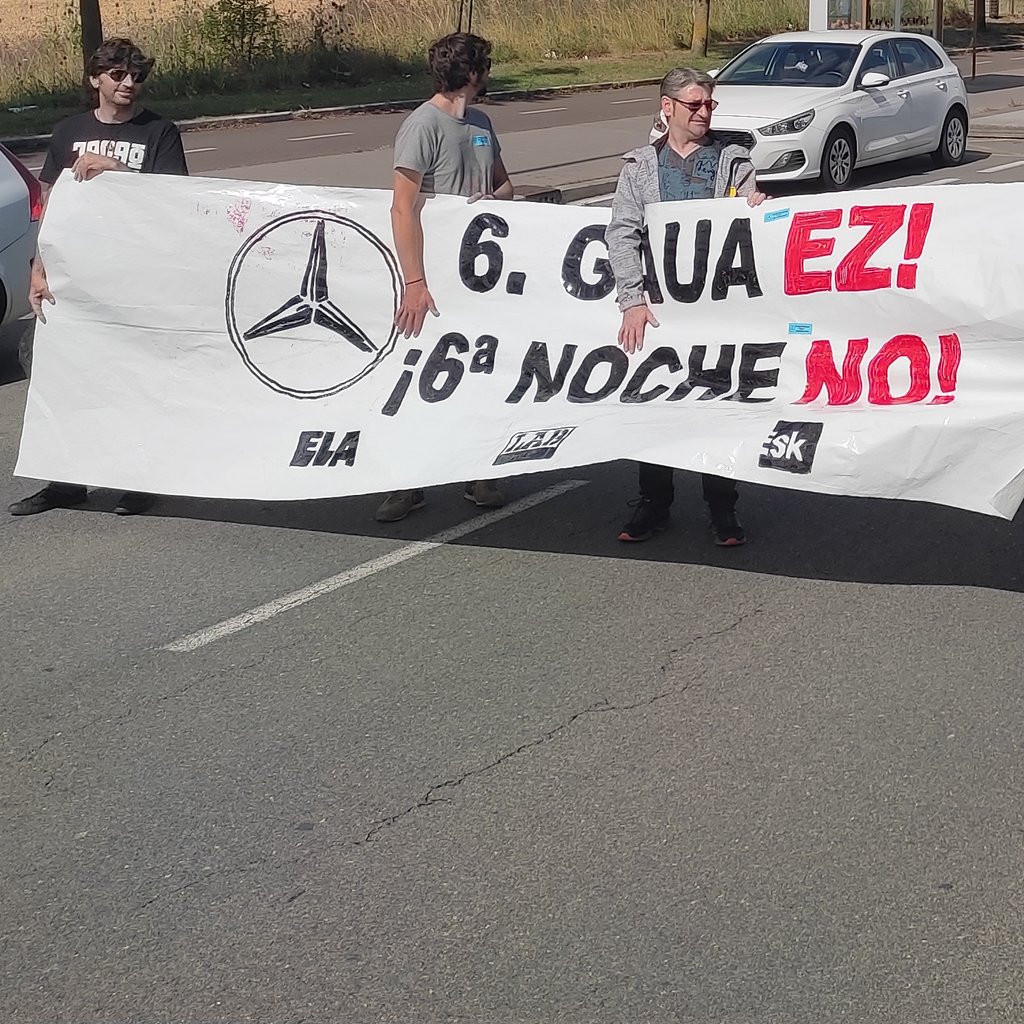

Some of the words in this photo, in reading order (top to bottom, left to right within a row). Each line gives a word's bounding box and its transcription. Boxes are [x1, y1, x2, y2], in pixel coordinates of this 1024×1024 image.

[459, 212, 527, 295] 6.
[783, 203, 935, 296] EZ!
[504, 340, 788, 404] NOCHE
[790, 332, 962, 406] NO!
[289, 430, 361, 468] ELA
